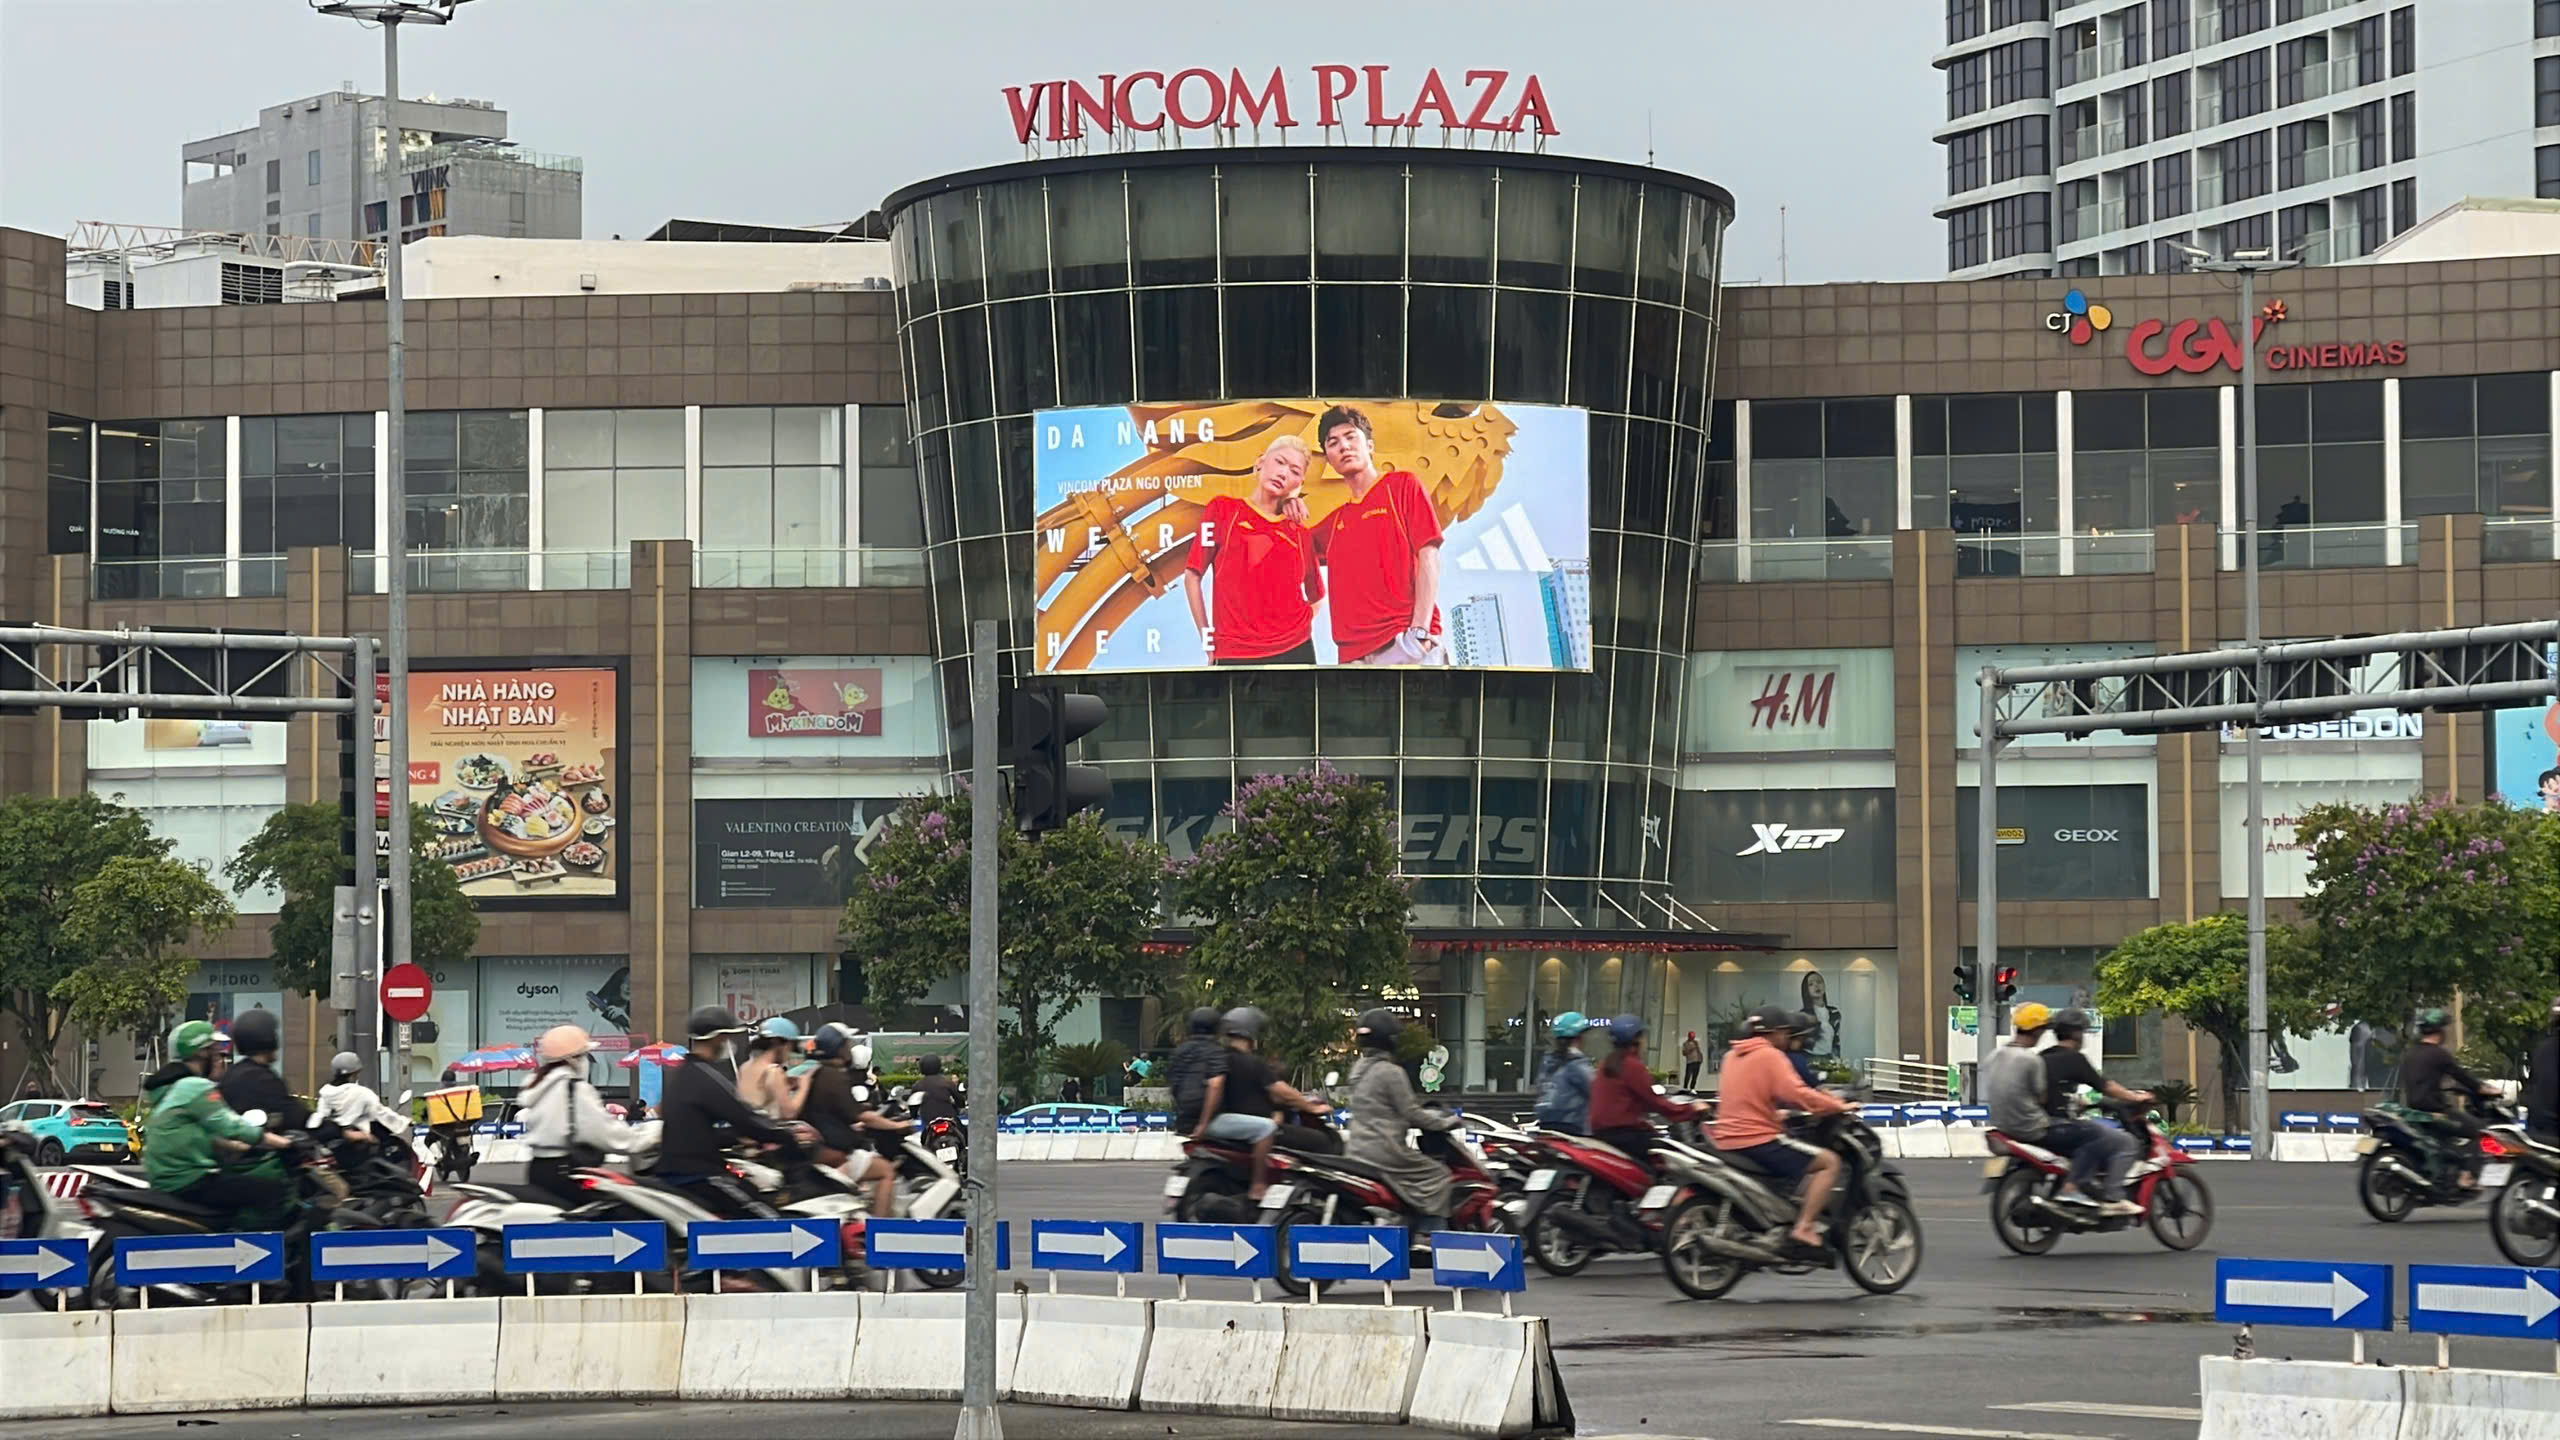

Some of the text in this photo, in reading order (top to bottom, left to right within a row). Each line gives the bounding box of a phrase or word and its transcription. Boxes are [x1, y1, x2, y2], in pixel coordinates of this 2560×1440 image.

[1001, 65, 1560, 144] VINCOM PLAZA
[2045, 313, 2072, 334] CJ
[2125, 318, 2265, 376] CGV
[2264, 340, 2408, 371] CINEMAS
[1047, 418, 1215, 450] DA NANG
[1056, 475, 1202, 495] VINCOM PLAZA NGO QUYEN
[1047, 626, 1216, 657] HERE
[442, 678, 556, 701] NHÀ HÀNG
[1750, 672, 1835, 729] H&M
[442, 699, 556, 731] NHẬT BẢN
[429, 770, 437, 780] 4
[725, 822, 791, 833] VALENTINO
[1100, 814, 1540, 863] SKERS
[1736, 823, 1846, 857] XTEP
[2053, 828, 2120, 842] GEOX
[785, 850, 796, 858] L2
[208, 974, 261, 987] PEDRO
[516, 981, 559, 999] dyson
